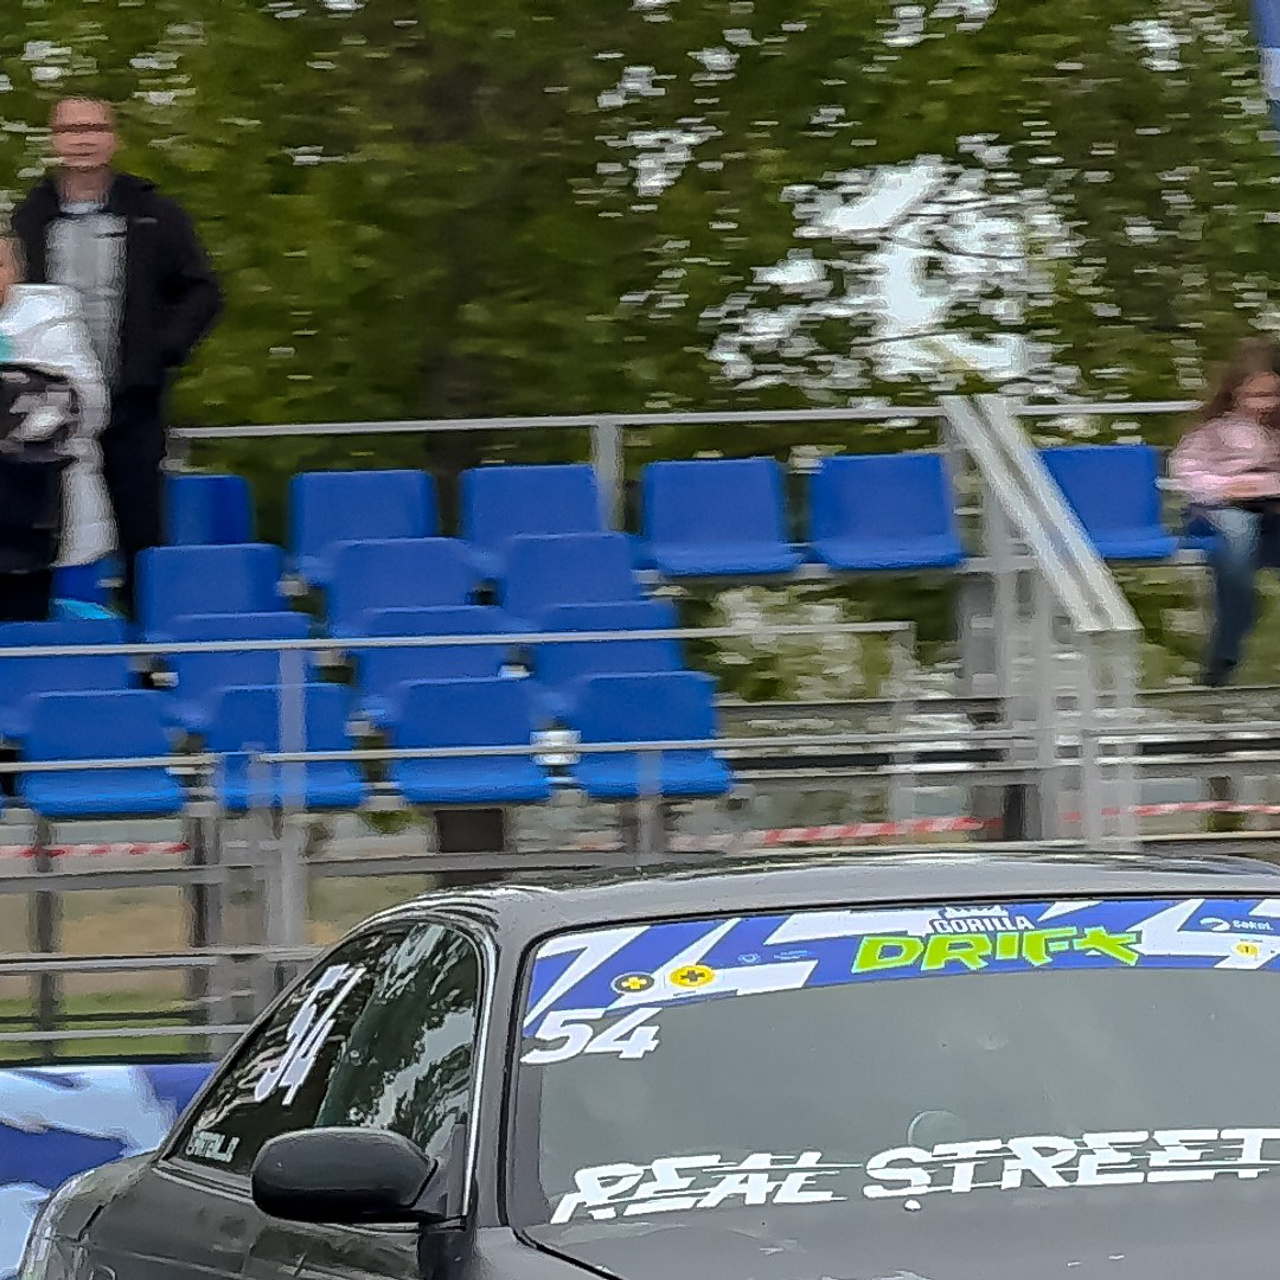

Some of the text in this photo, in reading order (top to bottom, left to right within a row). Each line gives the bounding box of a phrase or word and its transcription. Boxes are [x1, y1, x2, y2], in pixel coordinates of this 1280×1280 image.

[929, 916, 1036, 934] GORILLA
[520, 1007, 663, 1065] 54
[550, 1150, 862, 1224] REAL
